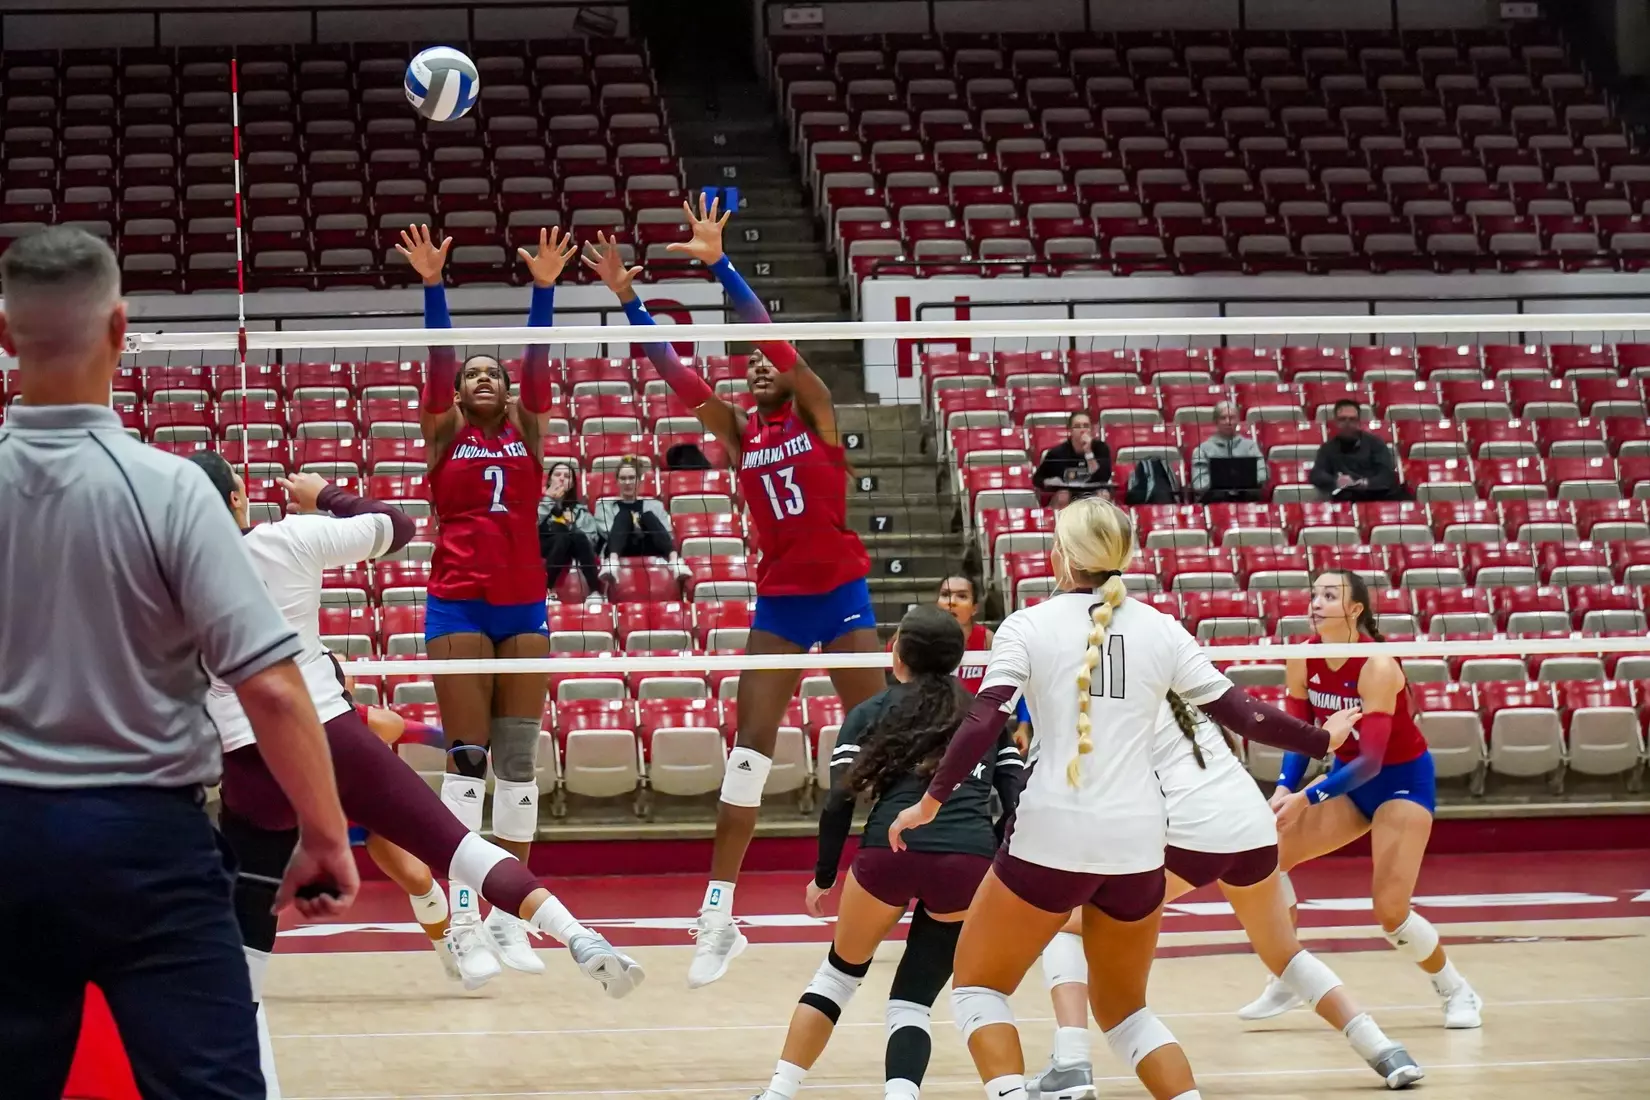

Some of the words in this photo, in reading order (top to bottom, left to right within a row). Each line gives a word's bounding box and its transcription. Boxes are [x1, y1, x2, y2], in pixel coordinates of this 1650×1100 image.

[723, 166, 737, 179] 15
[745, 229, 760, 242] 13
[756, 263, 771, 275] 12
[769, 299, 781, 312] 11
[784, 431, 813, 457] TECH
[847, 434, 859, 448] 9
[503, 441, 528, 457] TECH
[483, 465, 509, 512] 2
[860, 477, 873, 491] 8
[760, 466, 805, 520] 13
[875, 516, 887, 530] 7
[889, 559, 902, 573] 6
[961, 666, 984, 680] TECH
[1086, 634, 1126, 700] 11
